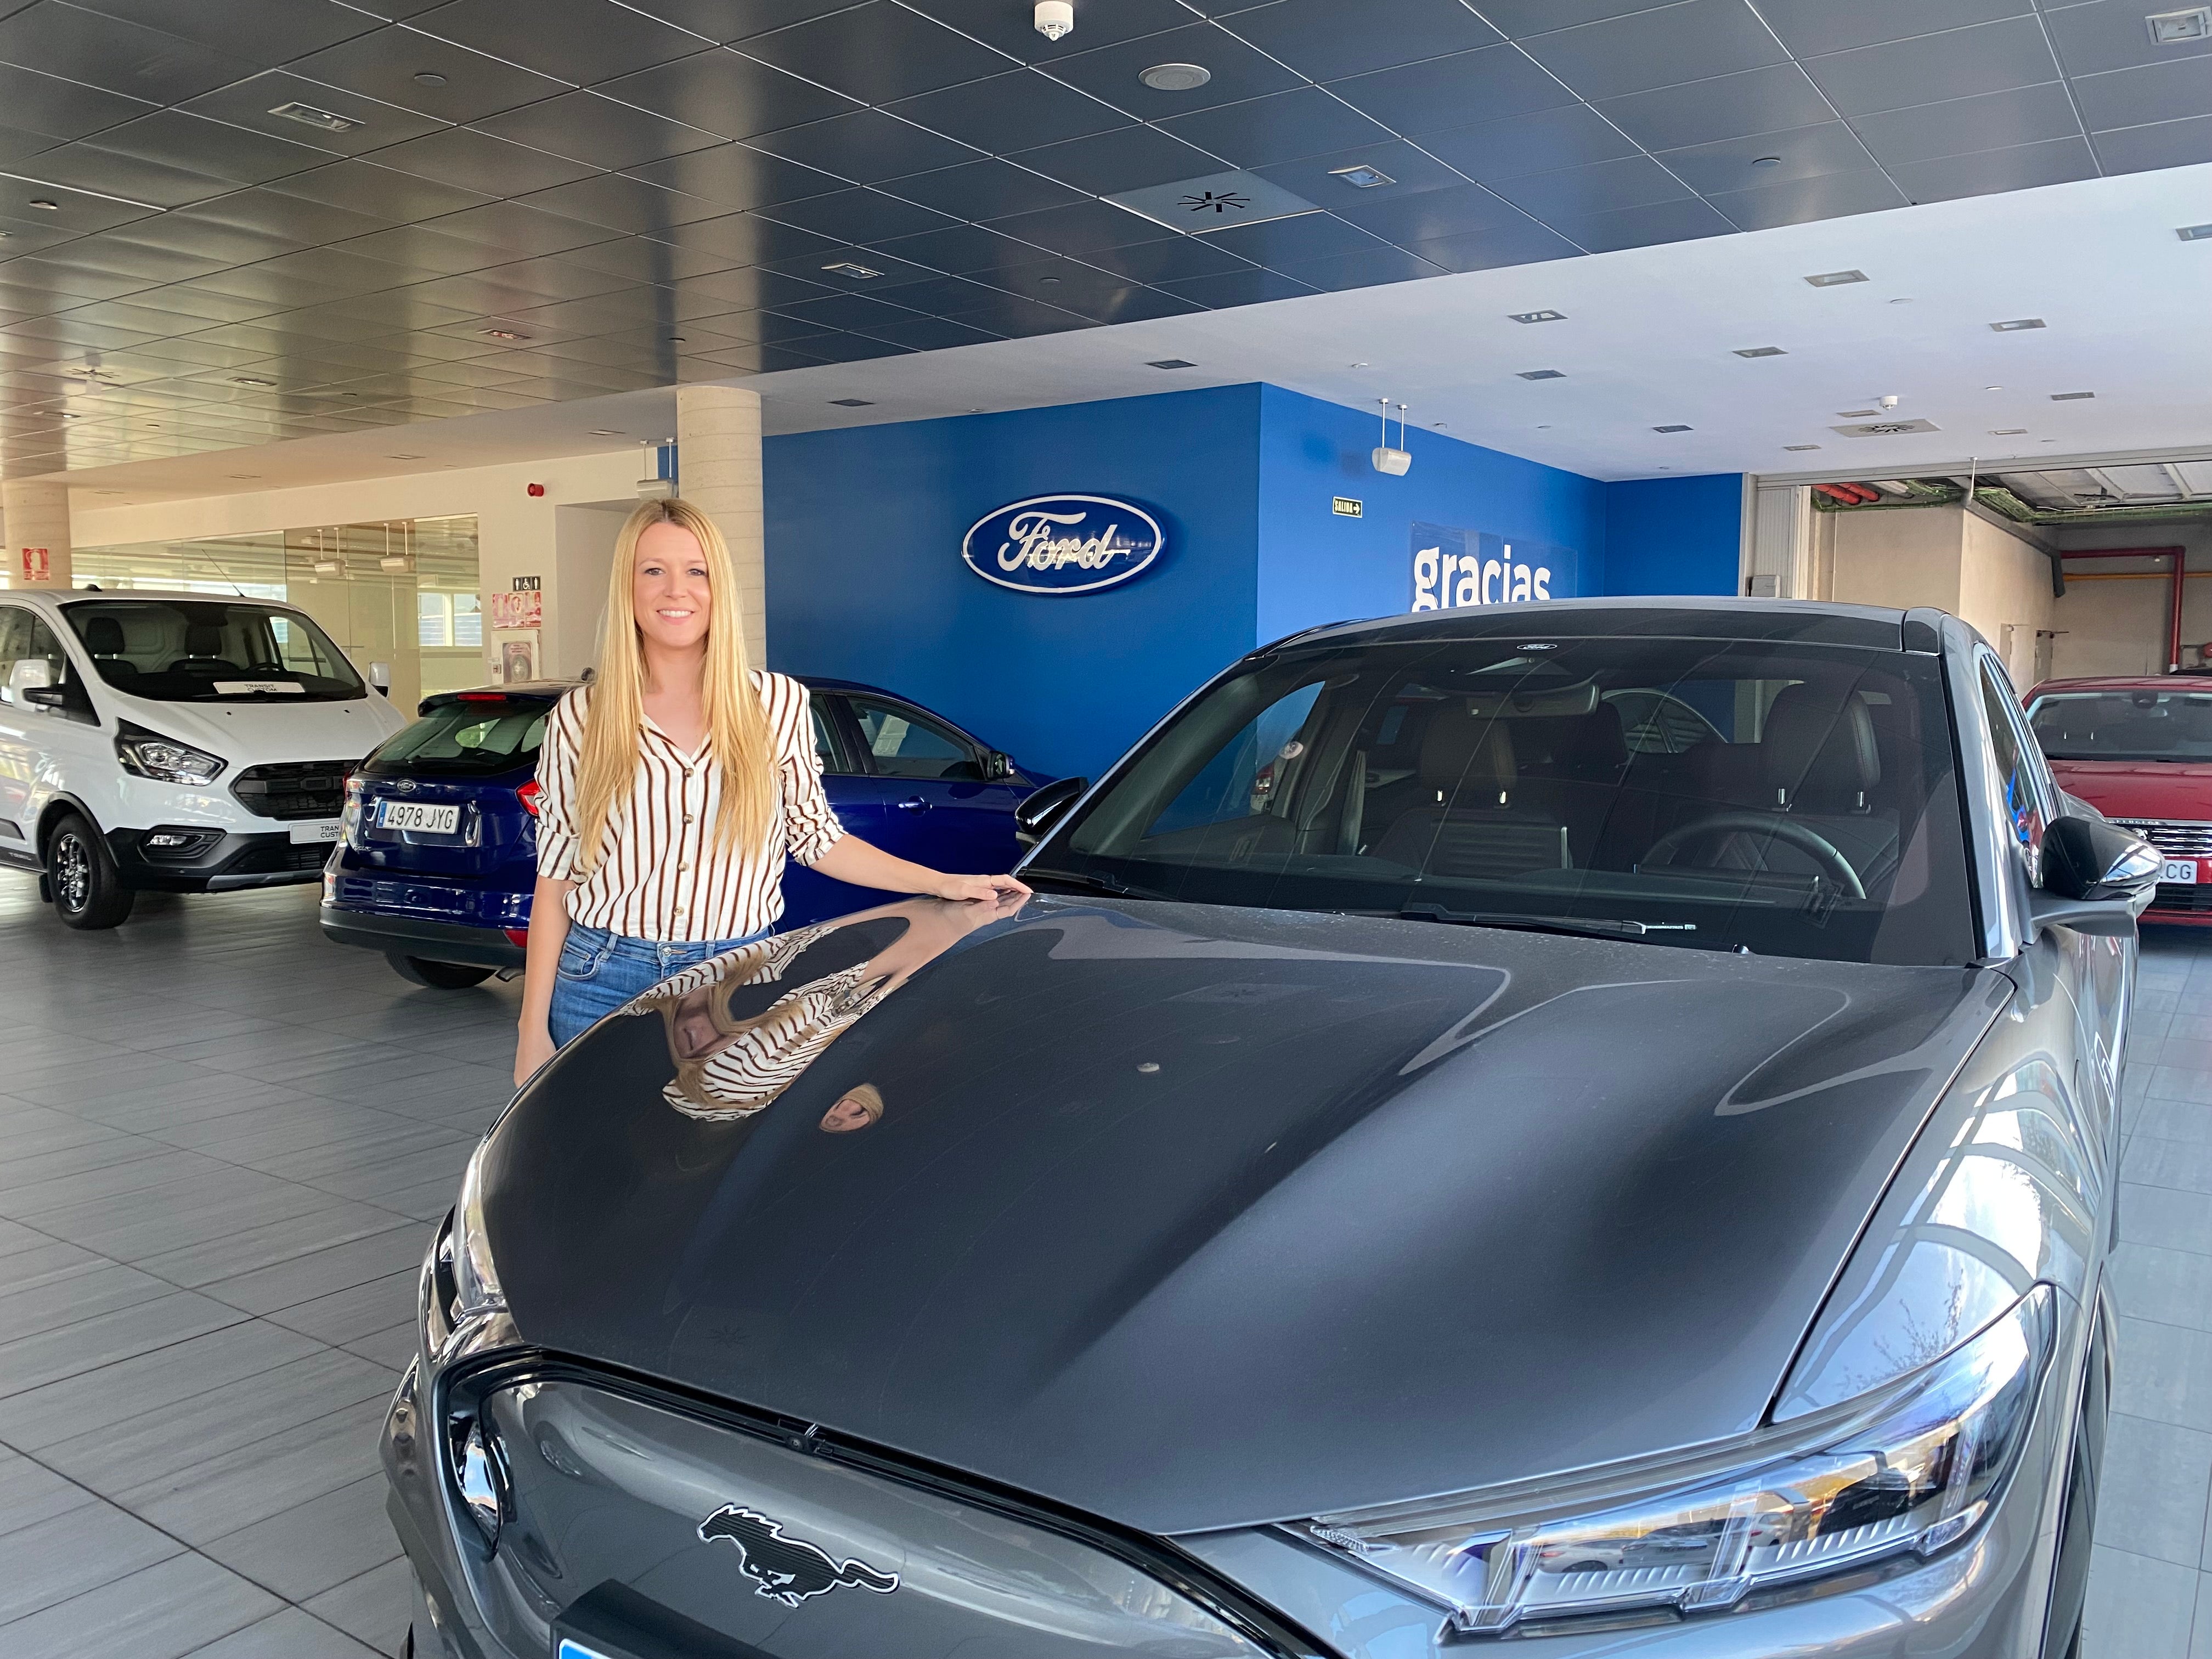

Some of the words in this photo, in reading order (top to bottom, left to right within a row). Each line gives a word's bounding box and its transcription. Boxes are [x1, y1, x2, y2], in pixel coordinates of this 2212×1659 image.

[1335, 500, 1353, 513] SALIDA
[997, 512, 1131, 571] Ford
[1412, 544, 1551, 613] gracias
[387, 805, 423, 827] 4978
[426, 809, 453, 830] JYG
[2160, 864, 2191, 879] CG
